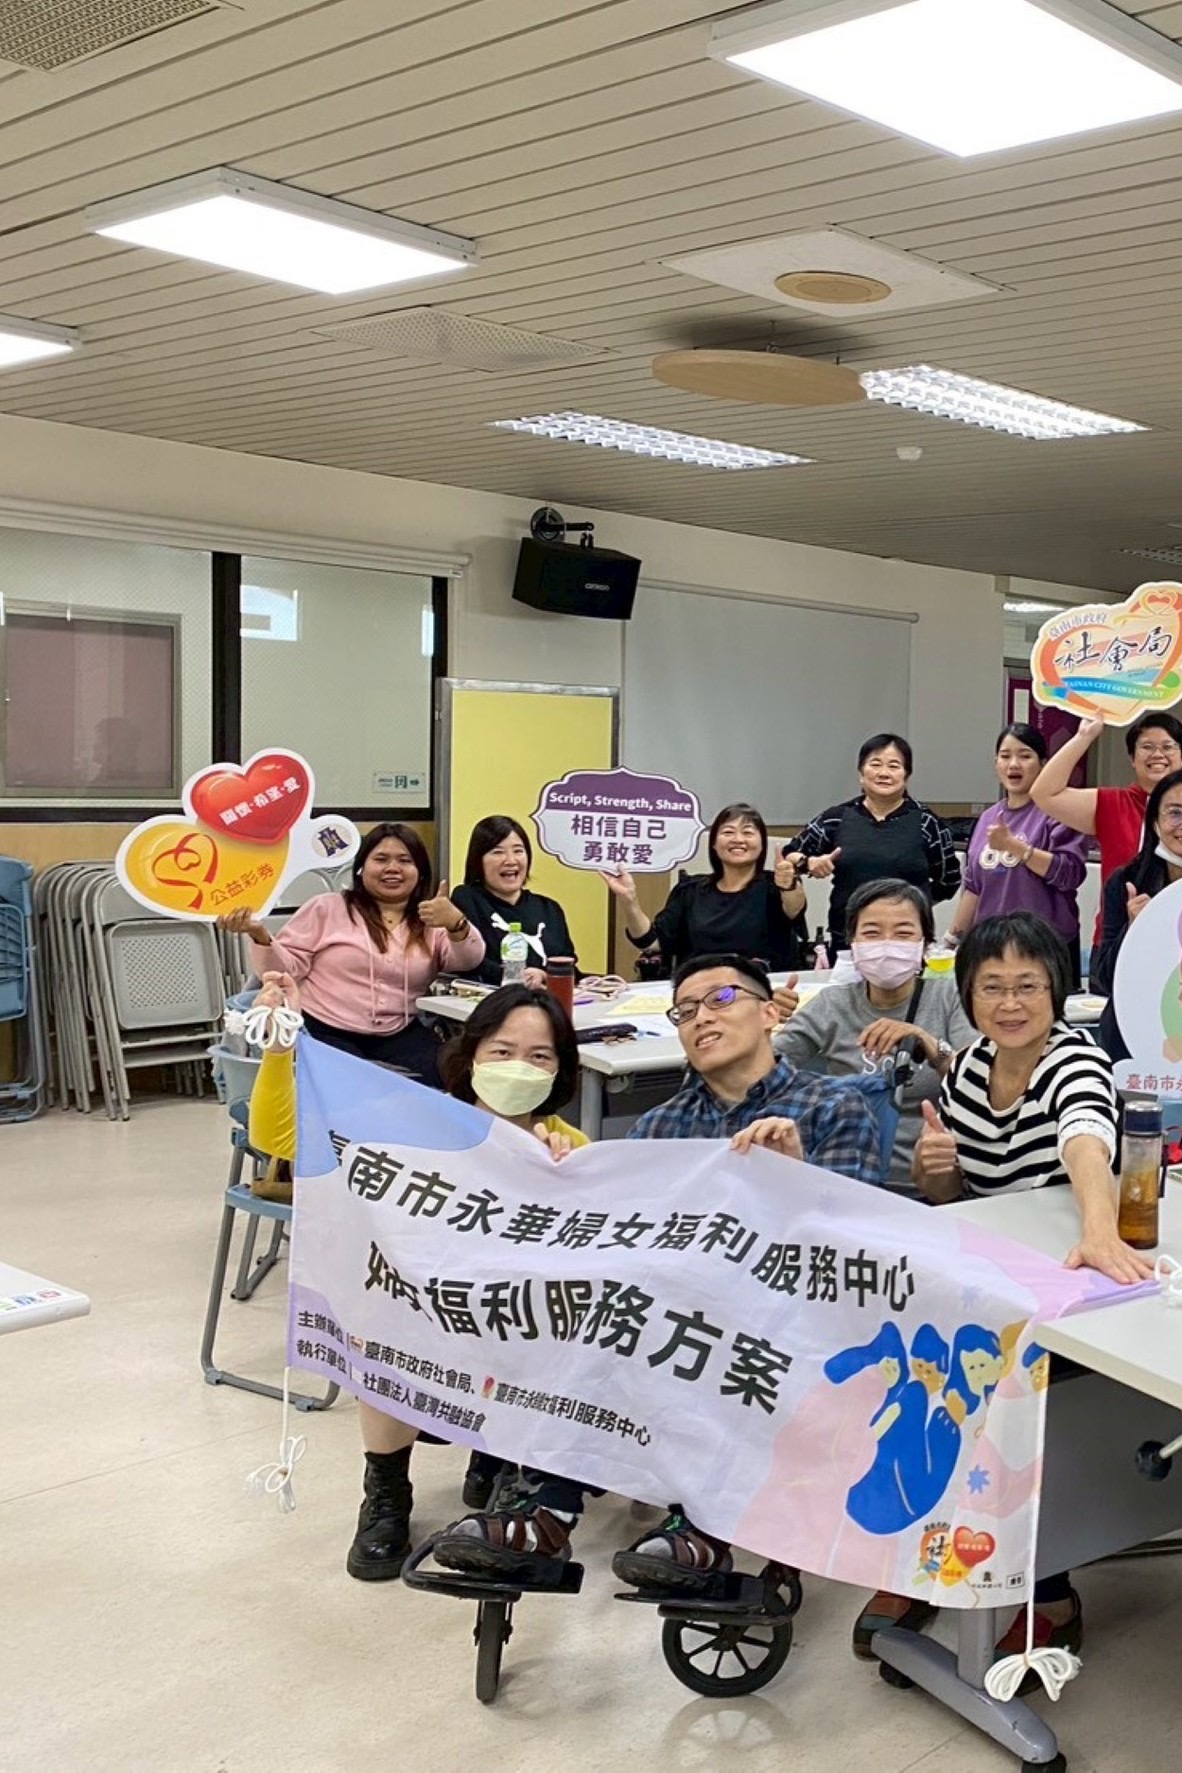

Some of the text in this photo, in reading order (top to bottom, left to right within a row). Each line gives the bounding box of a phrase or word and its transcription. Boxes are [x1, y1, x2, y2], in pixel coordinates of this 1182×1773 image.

[1054, 626, 1173, 673] 社會局
[550, 792, 692, 812] Script, Strength, Share
[571, 814, 667, 840] 相信自己
[583, 841, 653, 865] 勇敢愛
[210, 863, 275, 906] 公益彩券
